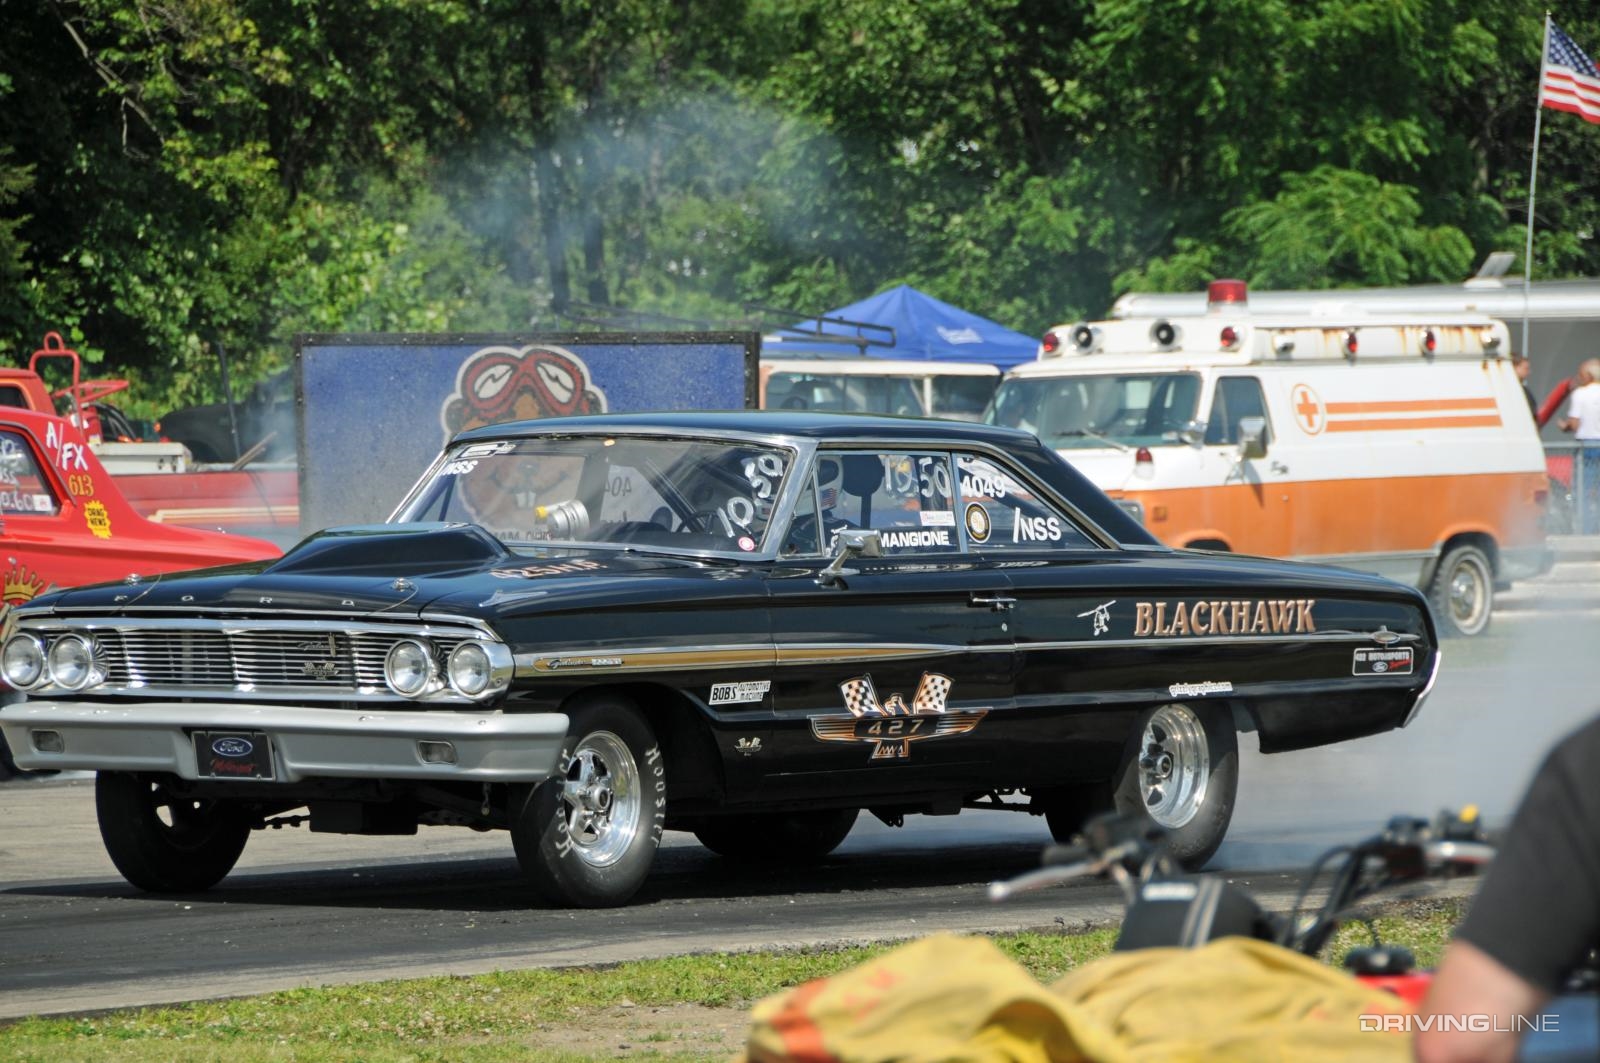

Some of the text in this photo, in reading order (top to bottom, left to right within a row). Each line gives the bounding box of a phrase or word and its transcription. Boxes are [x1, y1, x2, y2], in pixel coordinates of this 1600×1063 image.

[46, 421, 88, 470] A/FX
[69, 474, 94, 496] 613
[960, 475, 1006, 498] 4049
[90, 517, 107, 526] NEWS
[881, 531, 950, 548] MANGIONE
[1134, 600, 1316, 636] BLACKHAWK
[868, 719, 925, 735] 427
[219, 741, 244, 753] Ford
